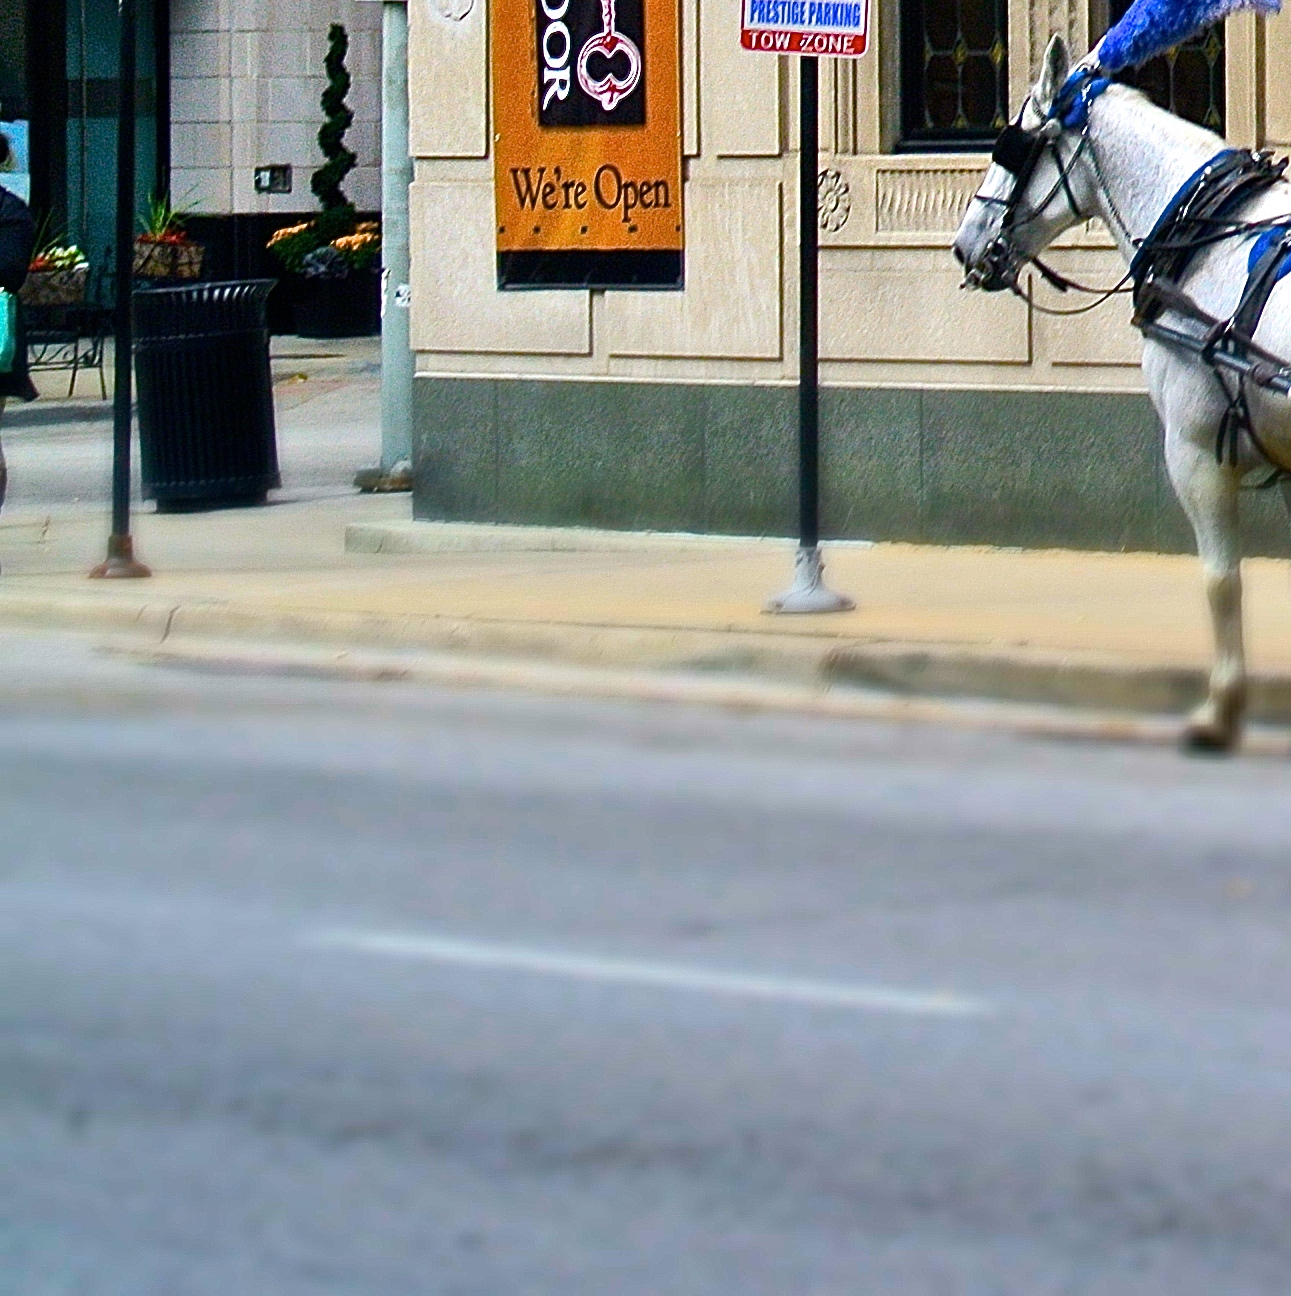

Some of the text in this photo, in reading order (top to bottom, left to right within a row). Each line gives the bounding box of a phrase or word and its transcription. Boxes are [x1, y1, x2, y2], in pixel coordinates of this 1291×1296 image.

[750, 0, 861, 28] PRESTIGE PARKING
[749, 31, 856, 54] TOW ZONE
[509, 164, 674, 223] We're Open
